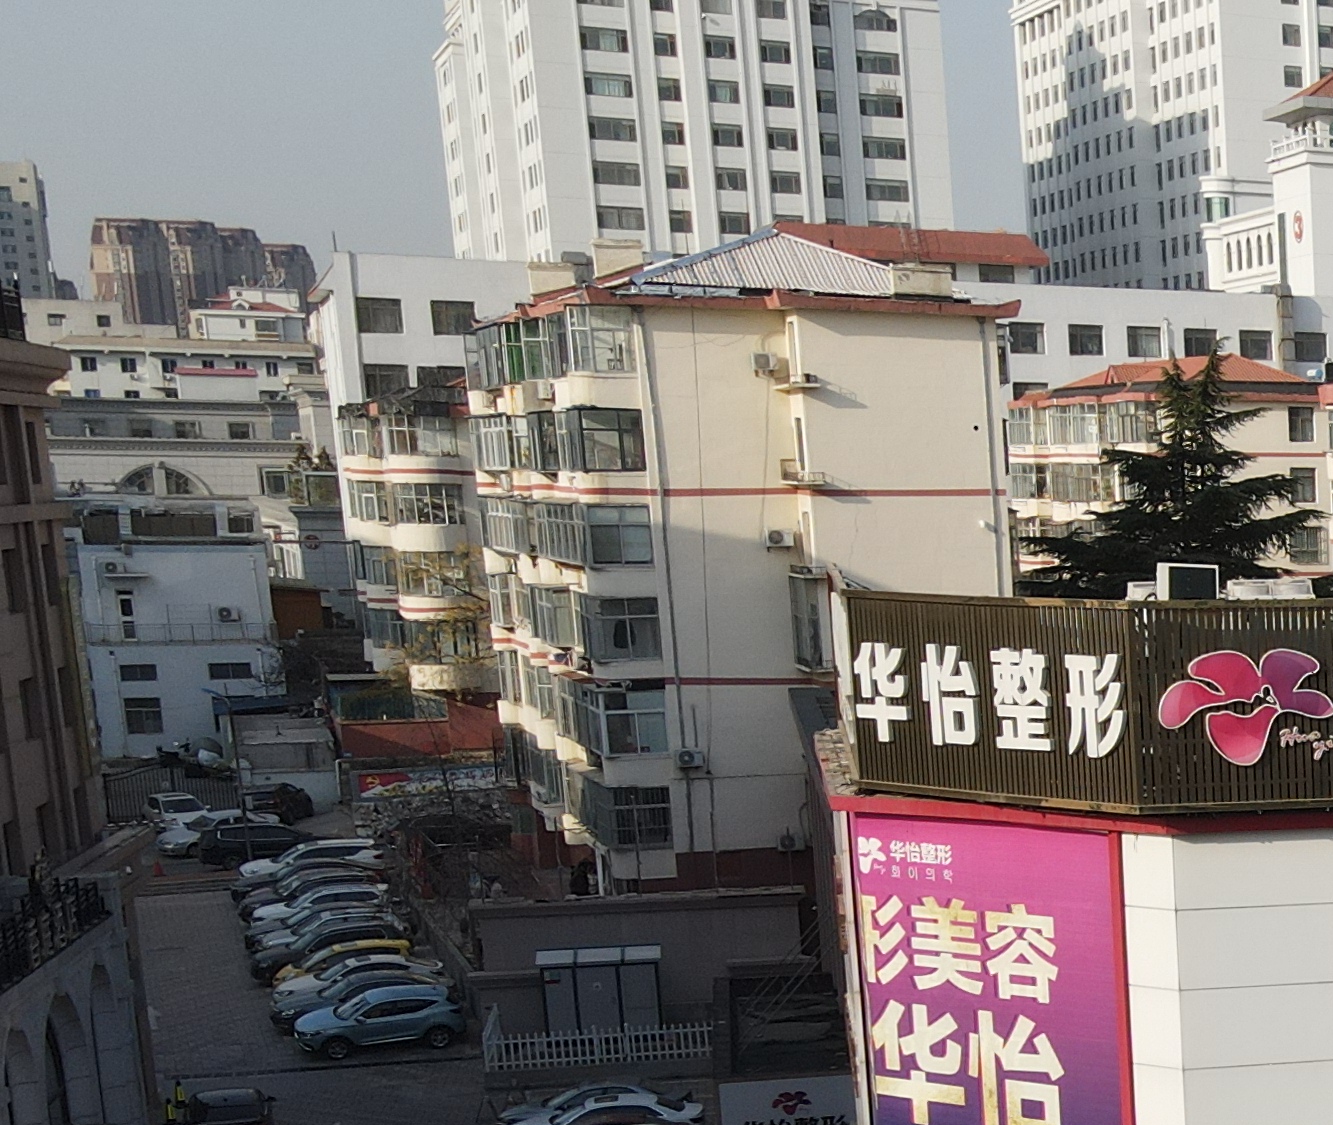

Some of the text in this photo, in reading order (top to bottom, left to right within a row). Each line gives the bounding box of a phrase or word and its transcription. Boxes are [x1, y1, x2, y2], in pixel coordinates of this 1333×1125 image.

[853, 641, 1129, 760] 华怡整形
[889, 839, 953, 866] 华怡整形
